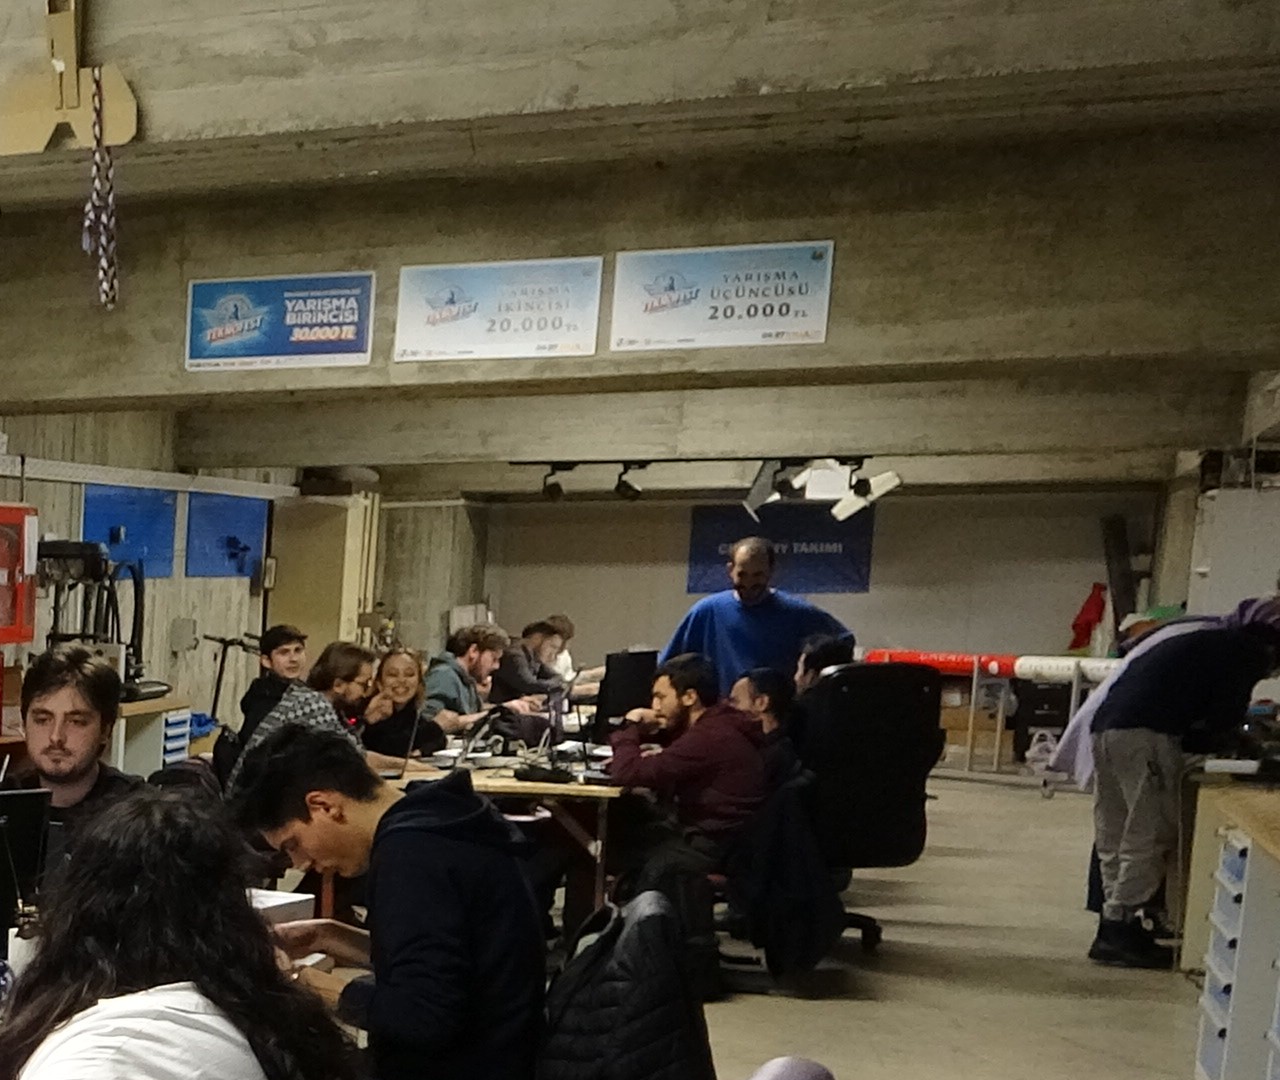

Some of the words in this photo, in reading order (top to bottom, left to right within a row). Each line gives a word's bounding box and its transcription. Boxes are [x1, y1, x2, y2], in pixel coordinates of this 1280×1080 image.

[722, 270, 799, 284] YARIŞMA
[710, 282, 810, 300] ÜÇÜNCÜSÜ
[285, 297, 358, 313] YARIŞMA
[708, 303, 791, 321] 20.000
[285, 311, 359, 326] BİRİNCİSİ
[485, 316, 564, 333] 20.000
